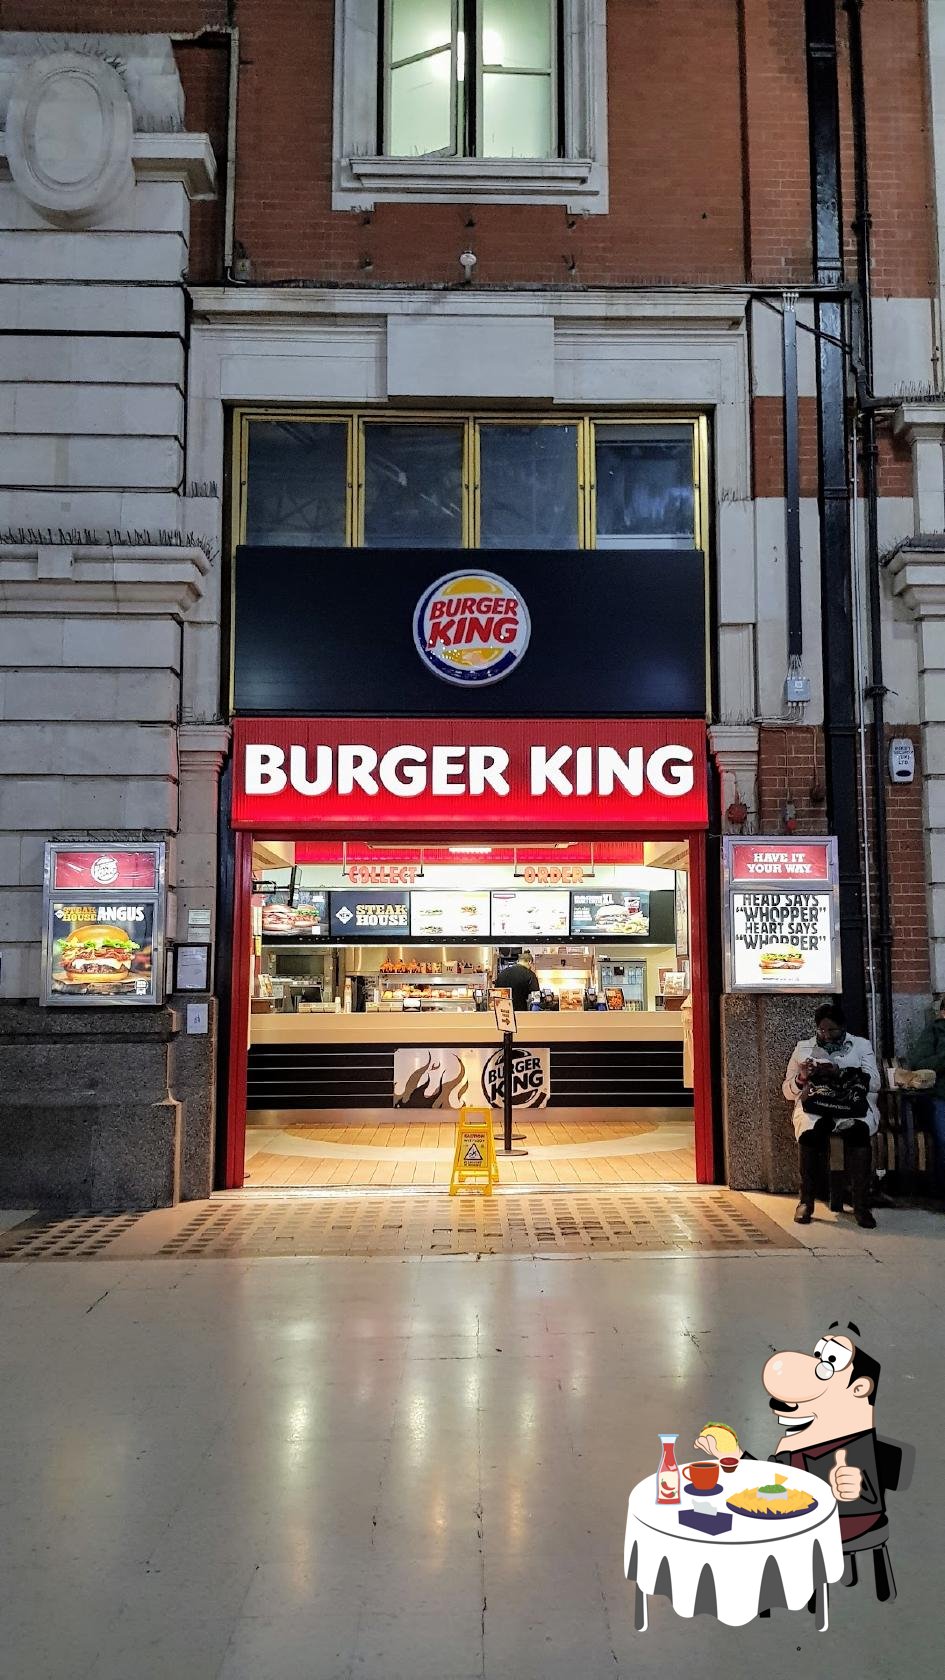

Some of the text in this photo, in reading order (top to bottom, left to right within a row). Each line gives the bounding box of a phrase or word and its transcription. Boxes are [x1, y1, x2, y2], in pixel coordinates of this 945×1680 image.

[429, 597, 519, 621] BURGER
[425, 616, 519, 649] KING
[245, 744, 694, 797] BURGER KING
[753, 853, 806, 863] HAVE IT
[348, 866, 417, 884] COLLECT
[524, 866, 584, 884] ORDER
[746, 864, 813, 874] YOUR WAY
[743, 894, 819, 907] HEAD SAYS
[62, 913, 97, 922] HOUSE
[97, 906, 145, 922] ANGUS
[356, 905, 408, 915] STEAK
[736, 907, 826, 922] “WHOPPER”
[356, 915, 408, 926] HOUSE
[745, 922, 818, 934] HEART SAYS
[489, 1057, 541, 1084] BUGER
[491, 1069, 543, 1101] KNG
